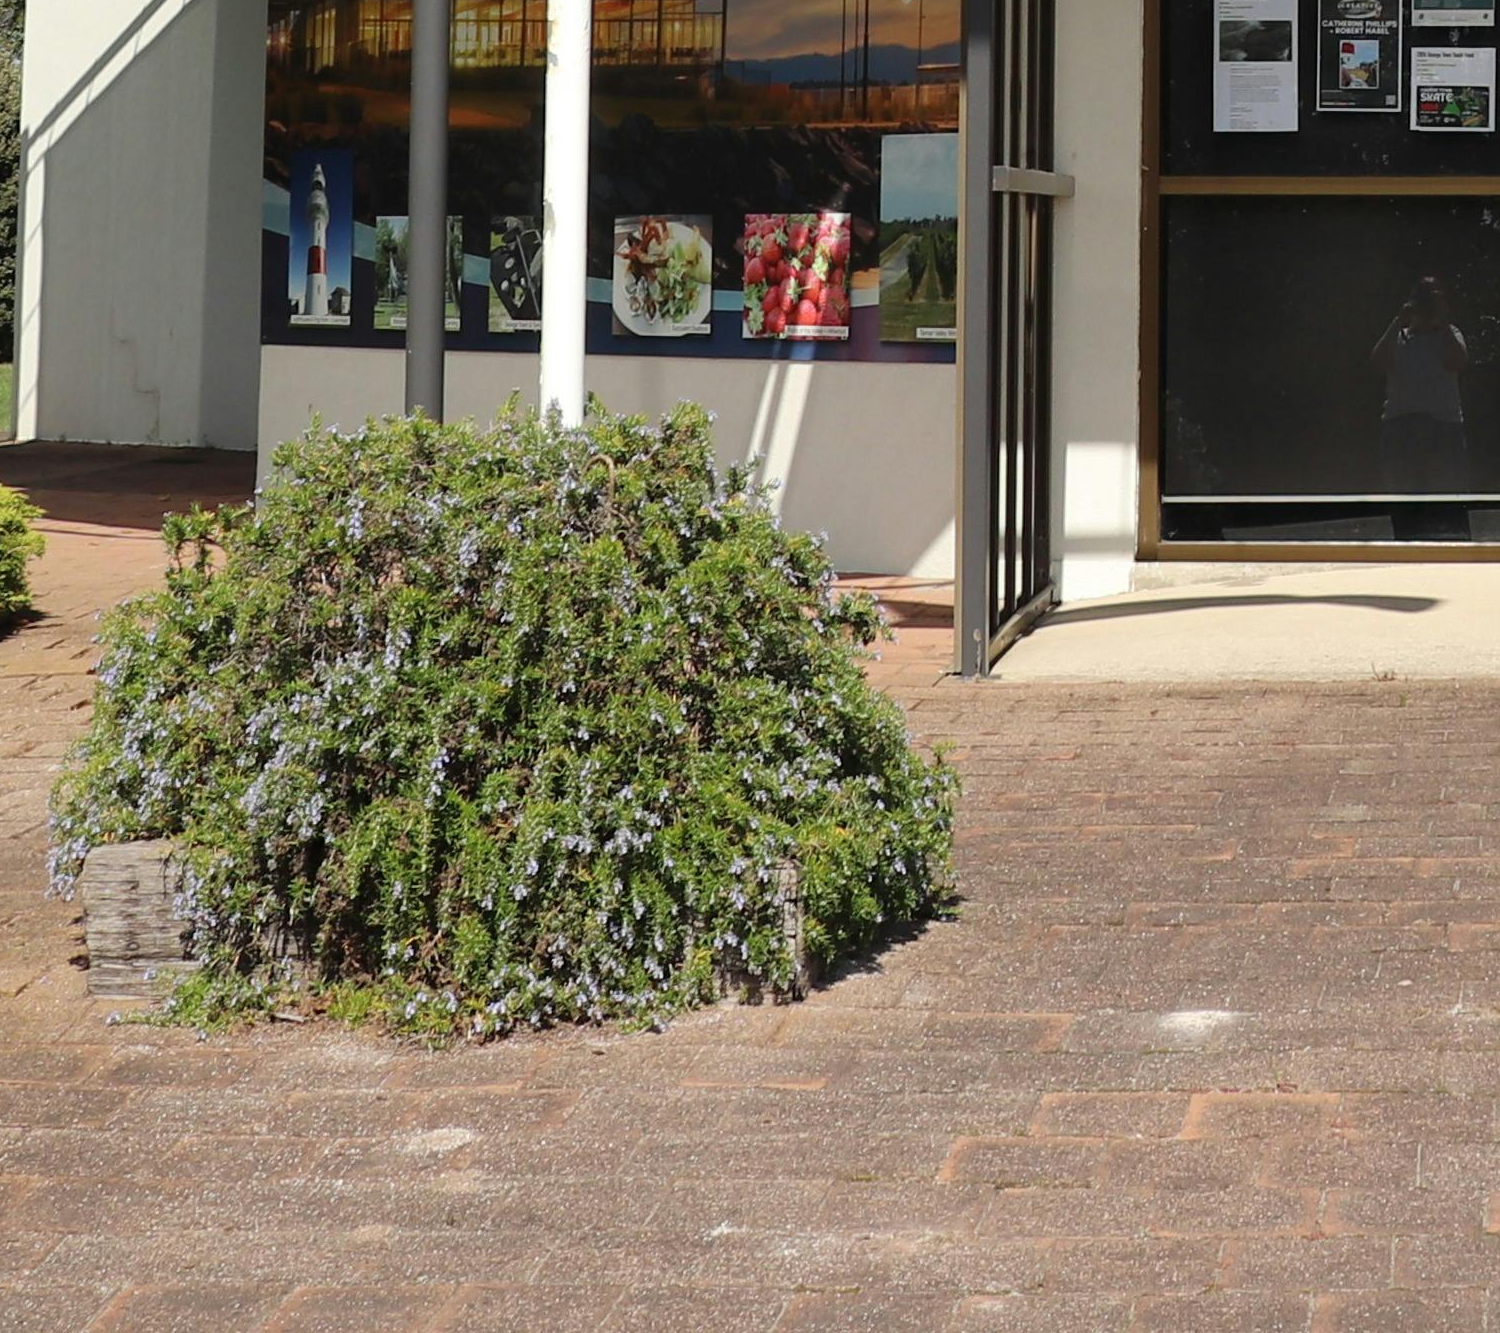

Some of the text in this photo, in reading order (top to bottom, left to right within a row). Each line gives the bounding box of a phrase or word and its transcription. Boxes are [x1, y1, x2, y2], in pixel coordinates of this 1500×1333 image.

[1322, 20, 1397, 29] CATHERINE PHILLIPS
[1420, 92, 1454, 102] SKATE
